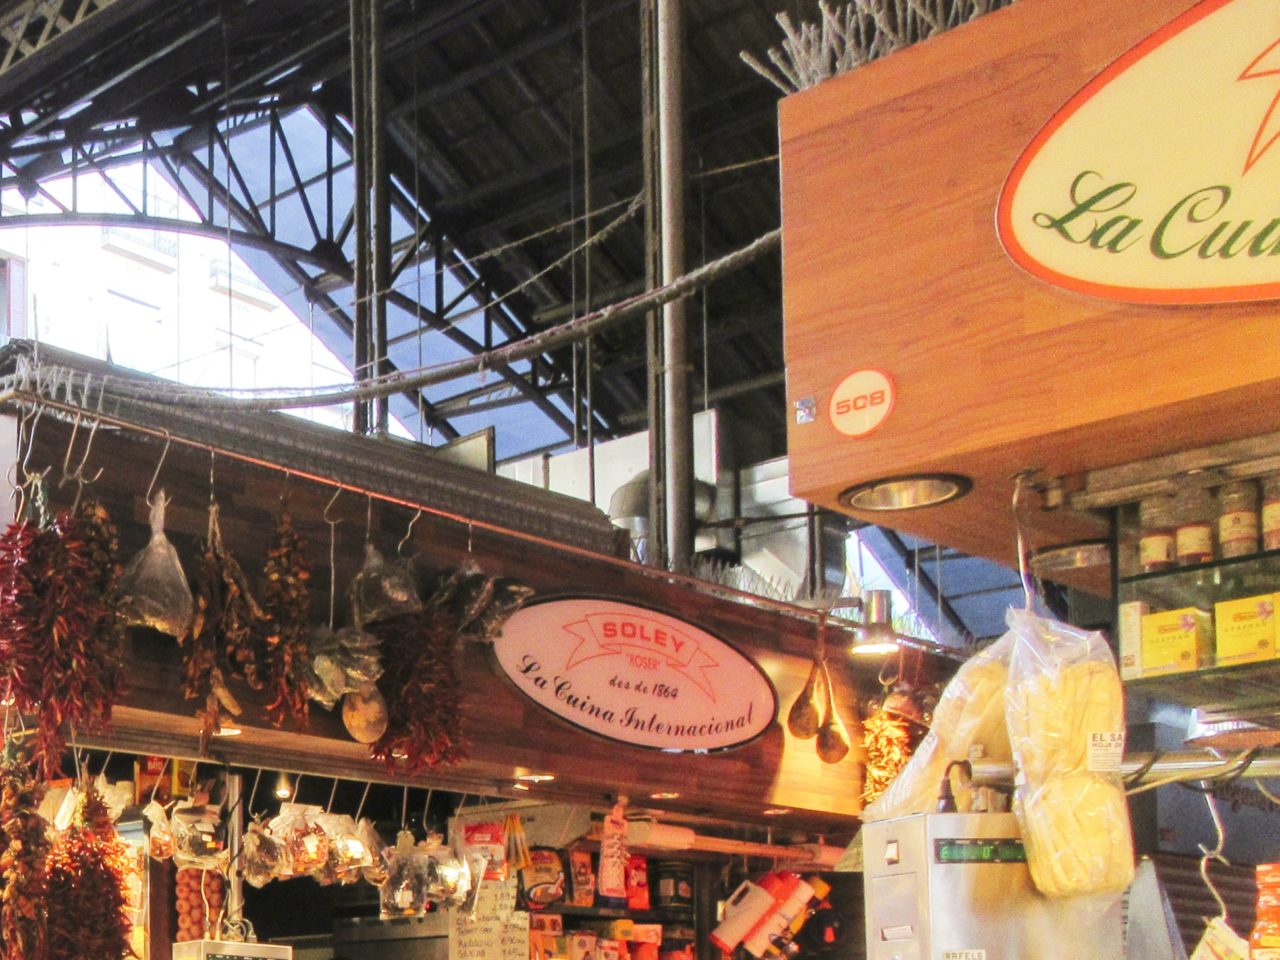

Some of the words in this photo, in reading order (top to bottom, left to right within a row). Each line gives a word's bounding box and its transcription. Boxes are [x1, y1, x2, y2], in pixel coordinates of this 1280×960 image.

[1032, 170, 1145, 254] La
[1149, 184, 1280, 261] Cui
[835, 389, 886, 415] 508
[602, 621, 686, 654] SOLEY
[516, 654, 548, 690] La
[552, 675, 615, 722] Cuina
[618, 700, 754, 737] Internacional
[634, 679, 650, 695] de
[651, 683, 680, 700] 1864
[1110, 732, 1123, 742] SA
